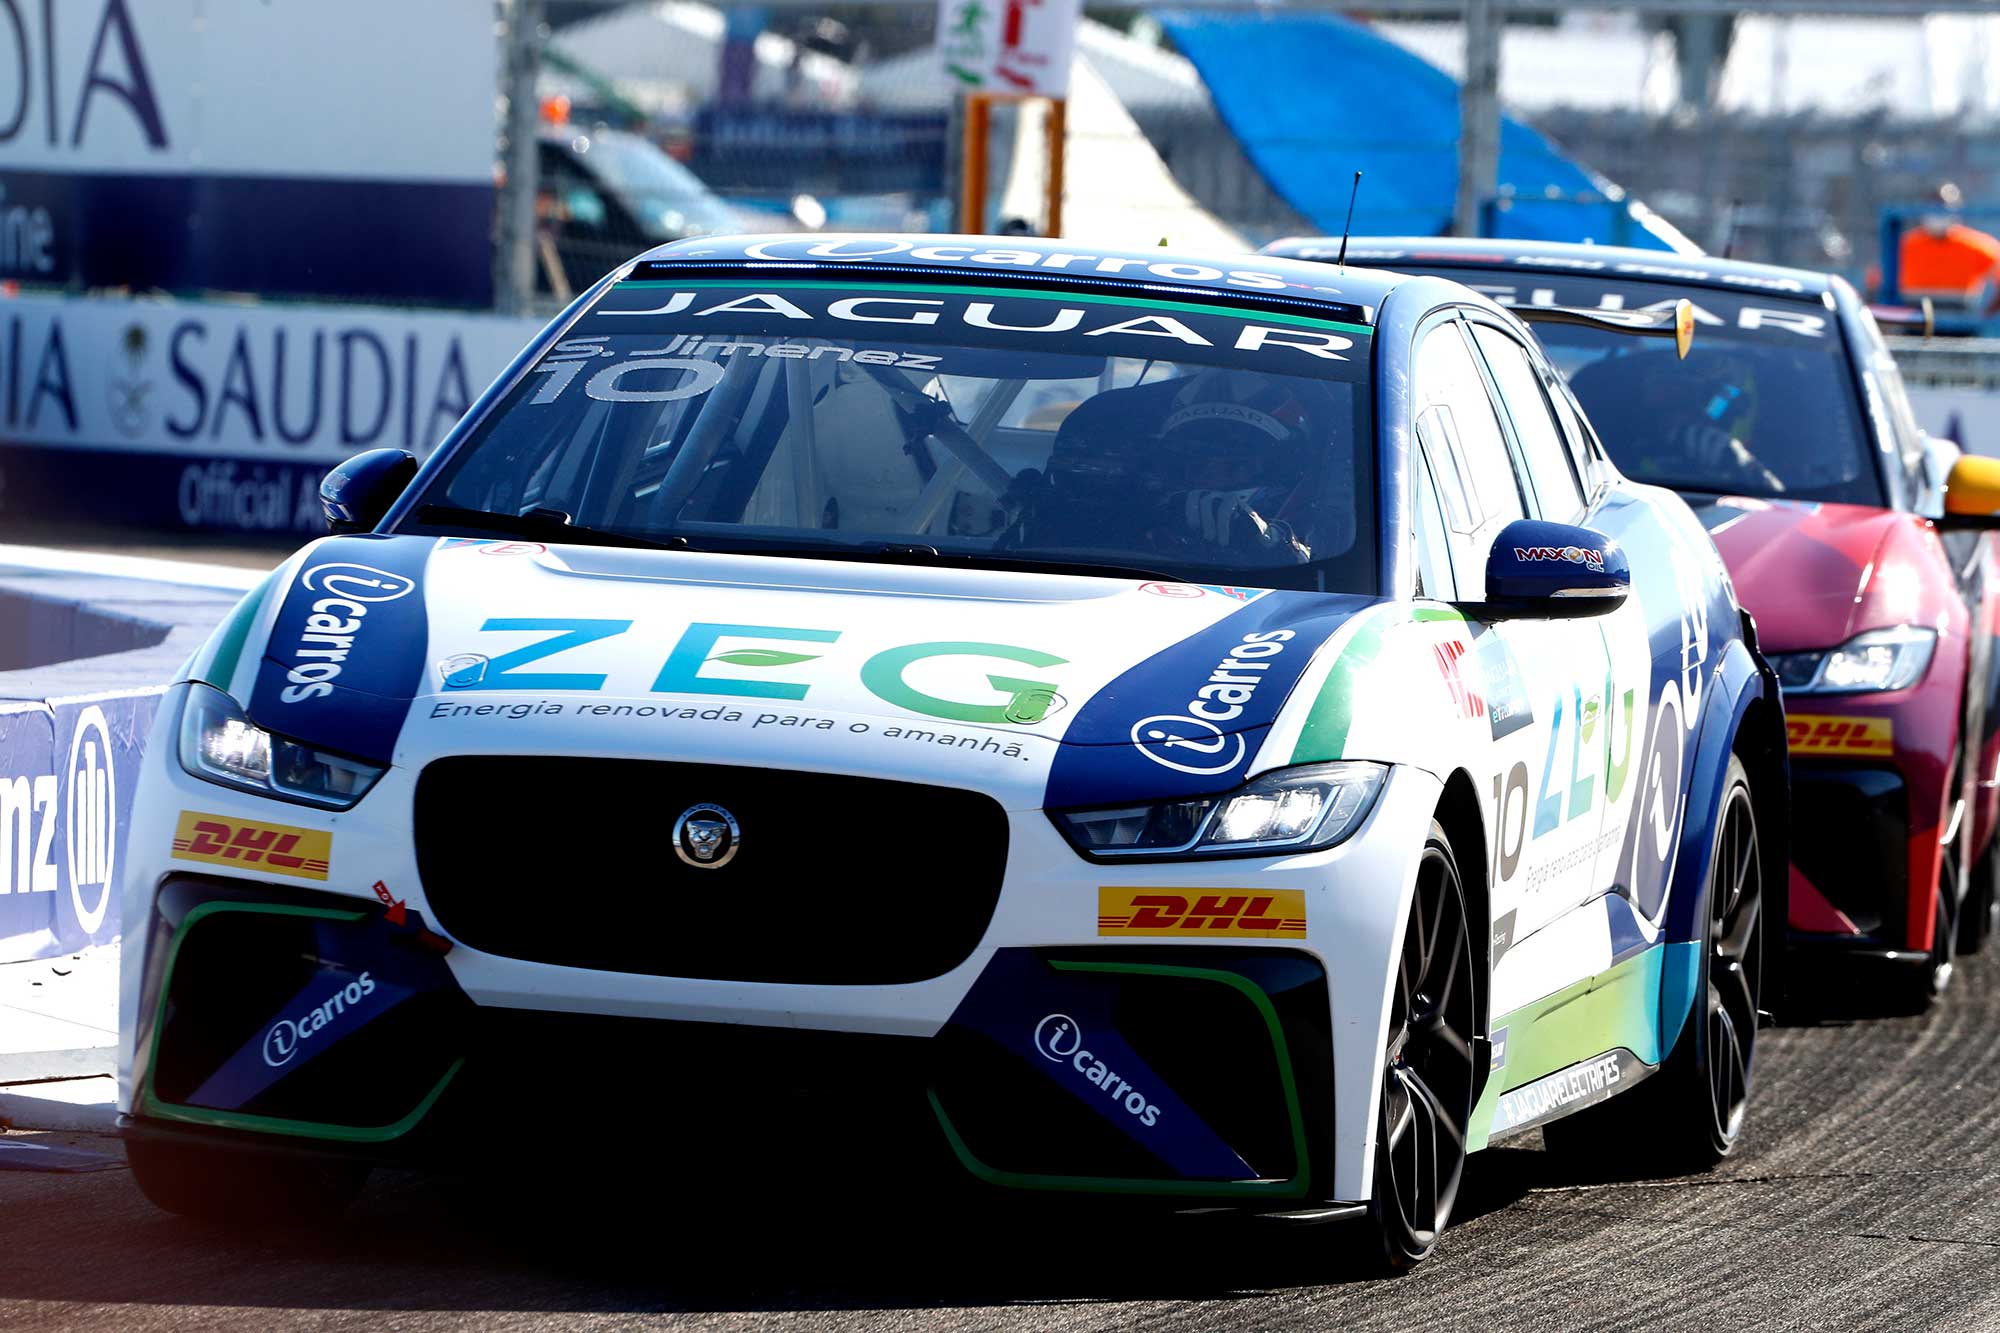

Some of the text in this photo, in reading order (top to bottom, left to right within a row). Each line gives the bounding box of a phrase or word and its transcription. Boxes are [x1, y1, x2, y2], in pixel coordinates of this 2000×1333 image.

[597, 292, 1354, 361] JAGUAR
[547, 333, 943, 371] S. Jimenez
[166, 320, 474, 446] SAUDIA
[529, 357, 726, 404] 10
[178, 463, 292, 529] Official
[1514, 546, 1604, 564] MAXON
[1586, 562, 1605, 573] OIL
[441, 618, 1071, 724] ZEG
[429, 700, 1031, 761] Energia renovada para o amanhã.
[1787, 721, 1874, 748] DHL
[188, 820, 306, 868] DHL
[1491, 760, 1529, 888] 10
[1127, 895, 1284, 930] DHL
